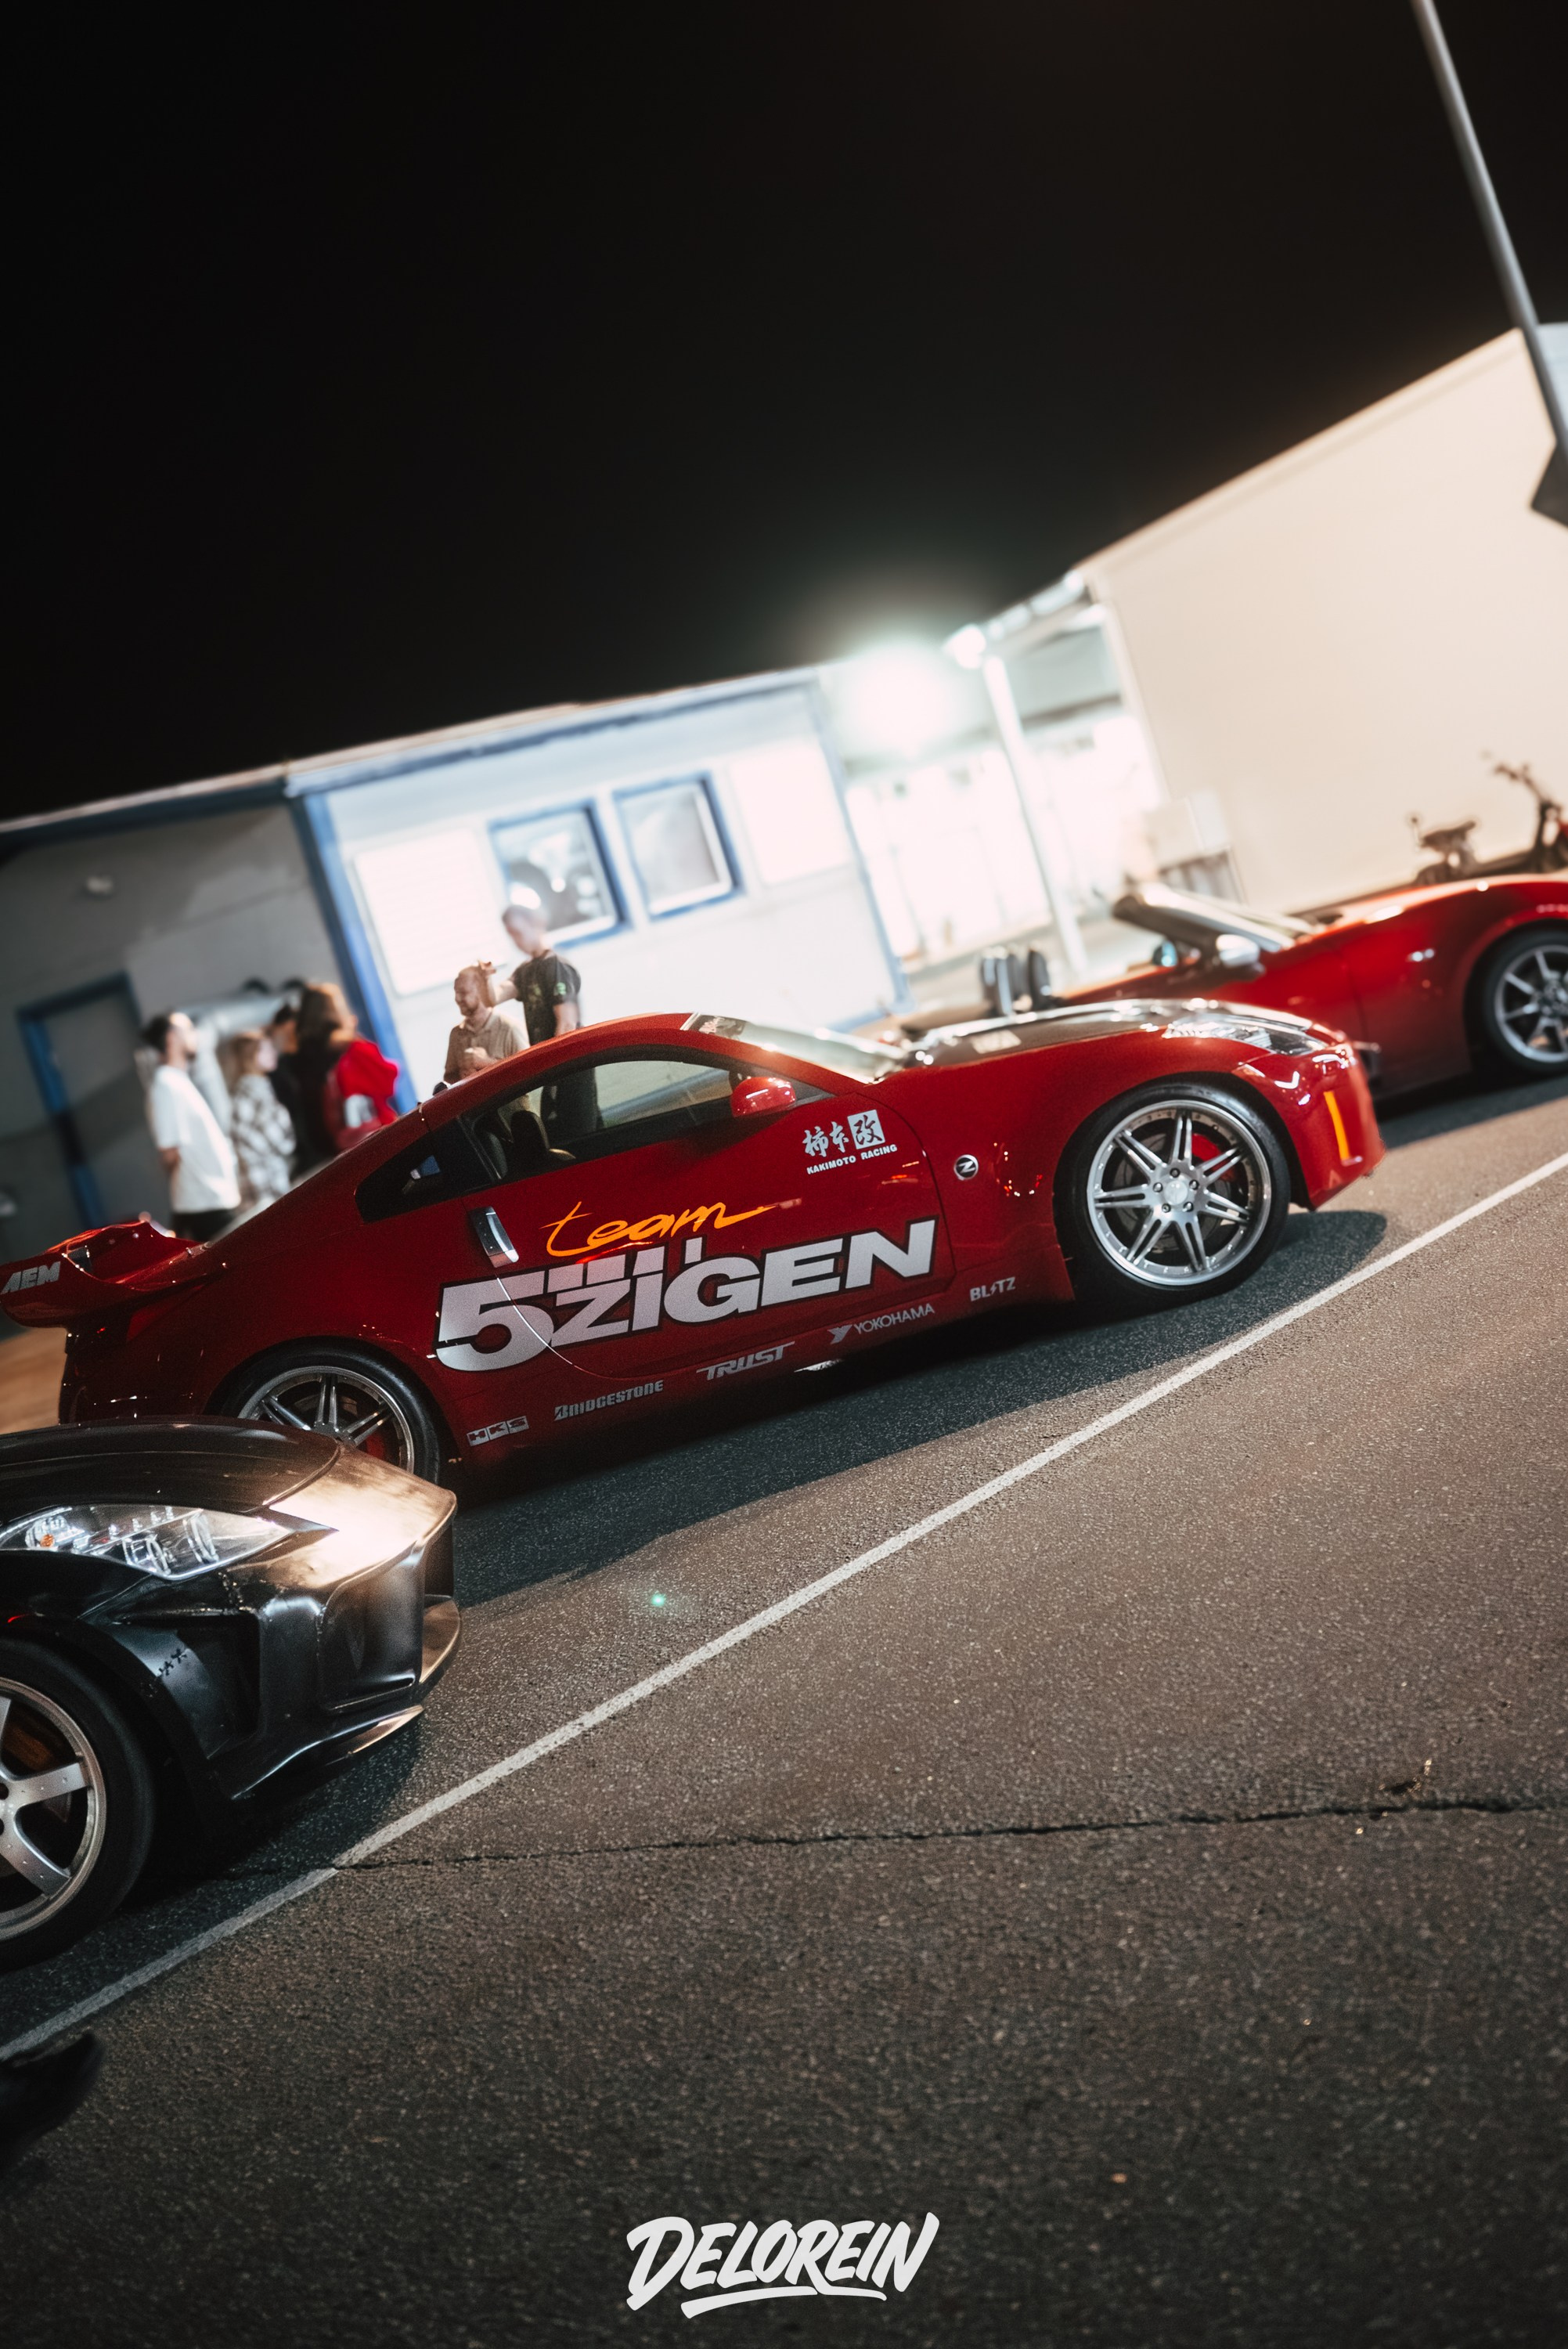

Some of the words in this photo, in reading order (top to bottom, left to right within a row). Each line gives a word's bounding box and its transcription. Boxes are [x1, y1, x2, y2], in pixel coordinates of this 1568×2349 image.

[802, 1110, 885, 1157] 柿本改
[806, 1155, 856, 1174] KAKIMOTO
[861, 1144, 897, 1160] RACING
[539, 1201, 777, 1257] team
[0, 1261, 61, 1294] AEM
[849, 1303, 935, 1336] YOKOHAMA
[697, 1341, 795, 1380] TRUST
[554, 1380, 664, 1421] BRIDGESTONE
[467, 1416, 528, 1445] HKS
